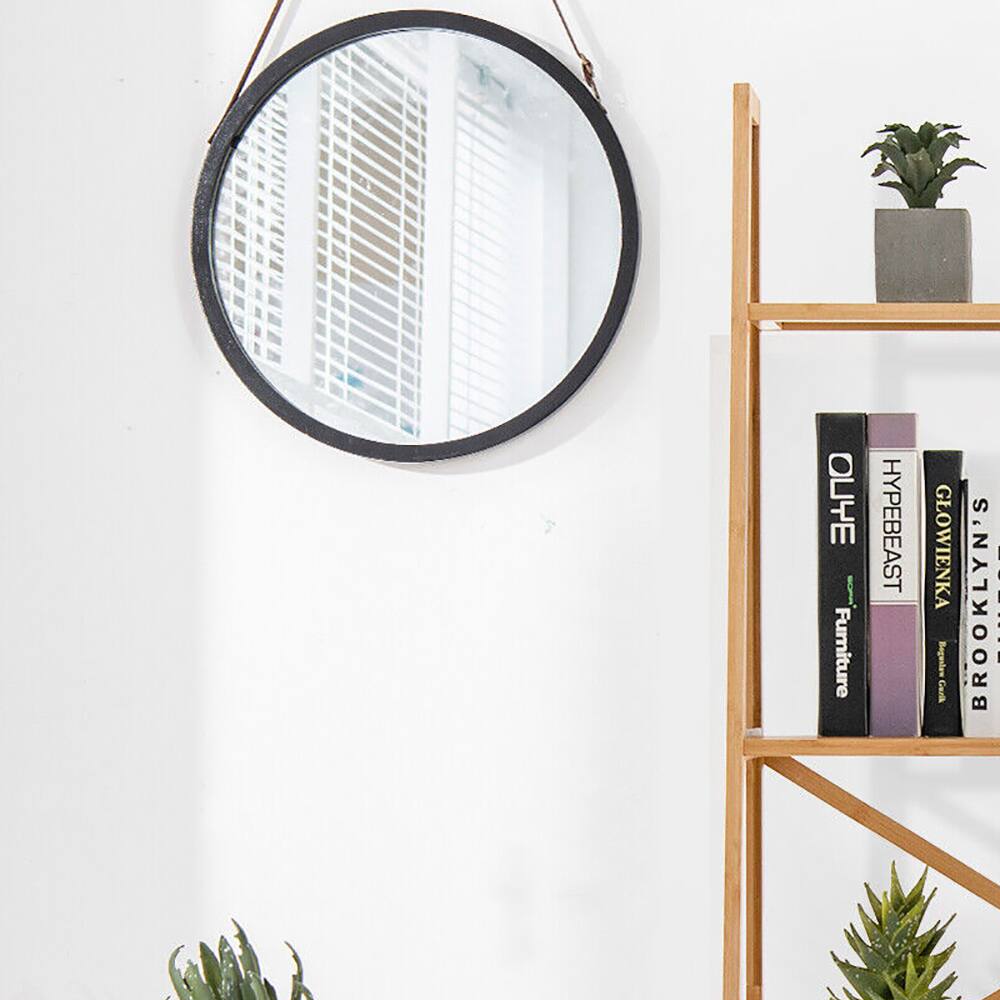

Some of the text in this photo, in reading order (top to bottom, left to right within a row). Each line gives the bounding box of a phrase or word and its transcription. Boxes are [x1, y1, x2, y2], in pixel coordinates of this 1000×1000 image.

[882, 459, 902, 593] HYPEBEAST
[835, 607, 851, 699] Furniture
[972, 498, 989, 711] BROOKLYN'S
